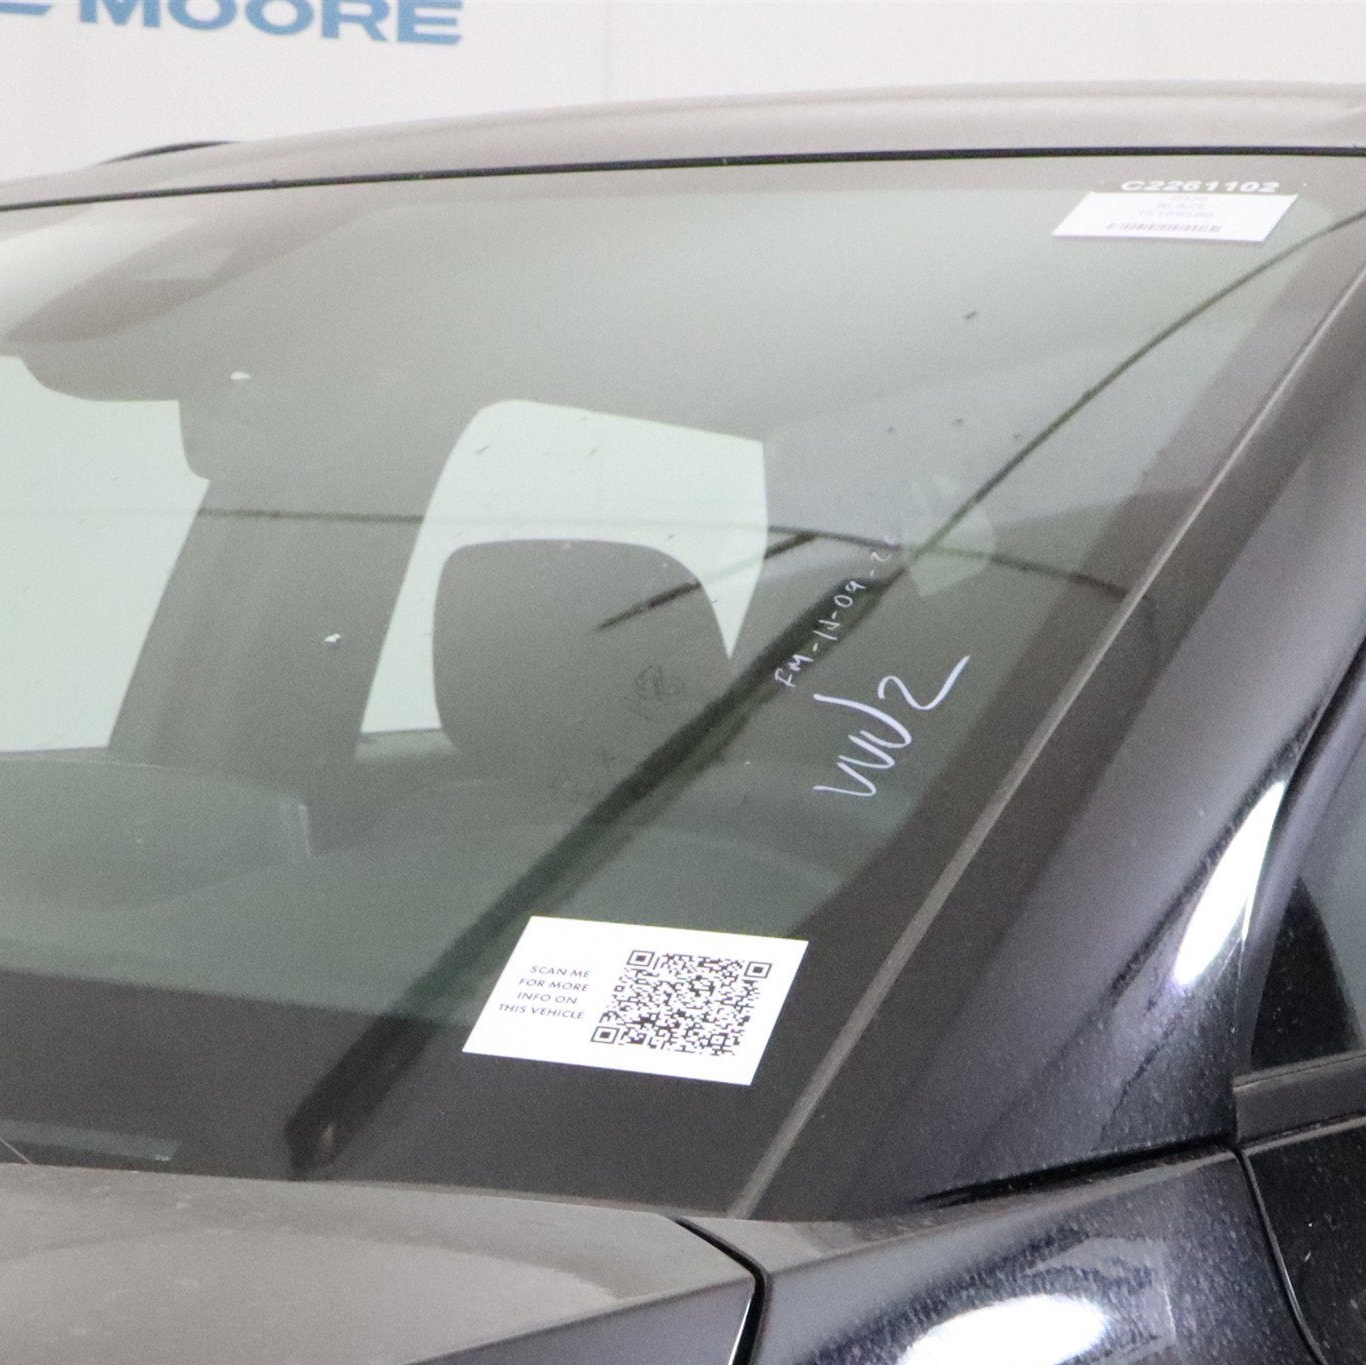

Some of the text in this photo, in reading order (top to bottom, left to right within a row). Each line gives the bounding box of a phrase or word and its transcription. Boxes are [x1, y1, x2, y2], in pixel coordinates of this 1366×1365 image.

[530, 965, 591, 978] SCAN ME
[518, 978, 590, 992] FOR MORE
[517, 992, 578, 1005] INFO ON
[498, 1003, 584, 1019] THIS VEHICLE
